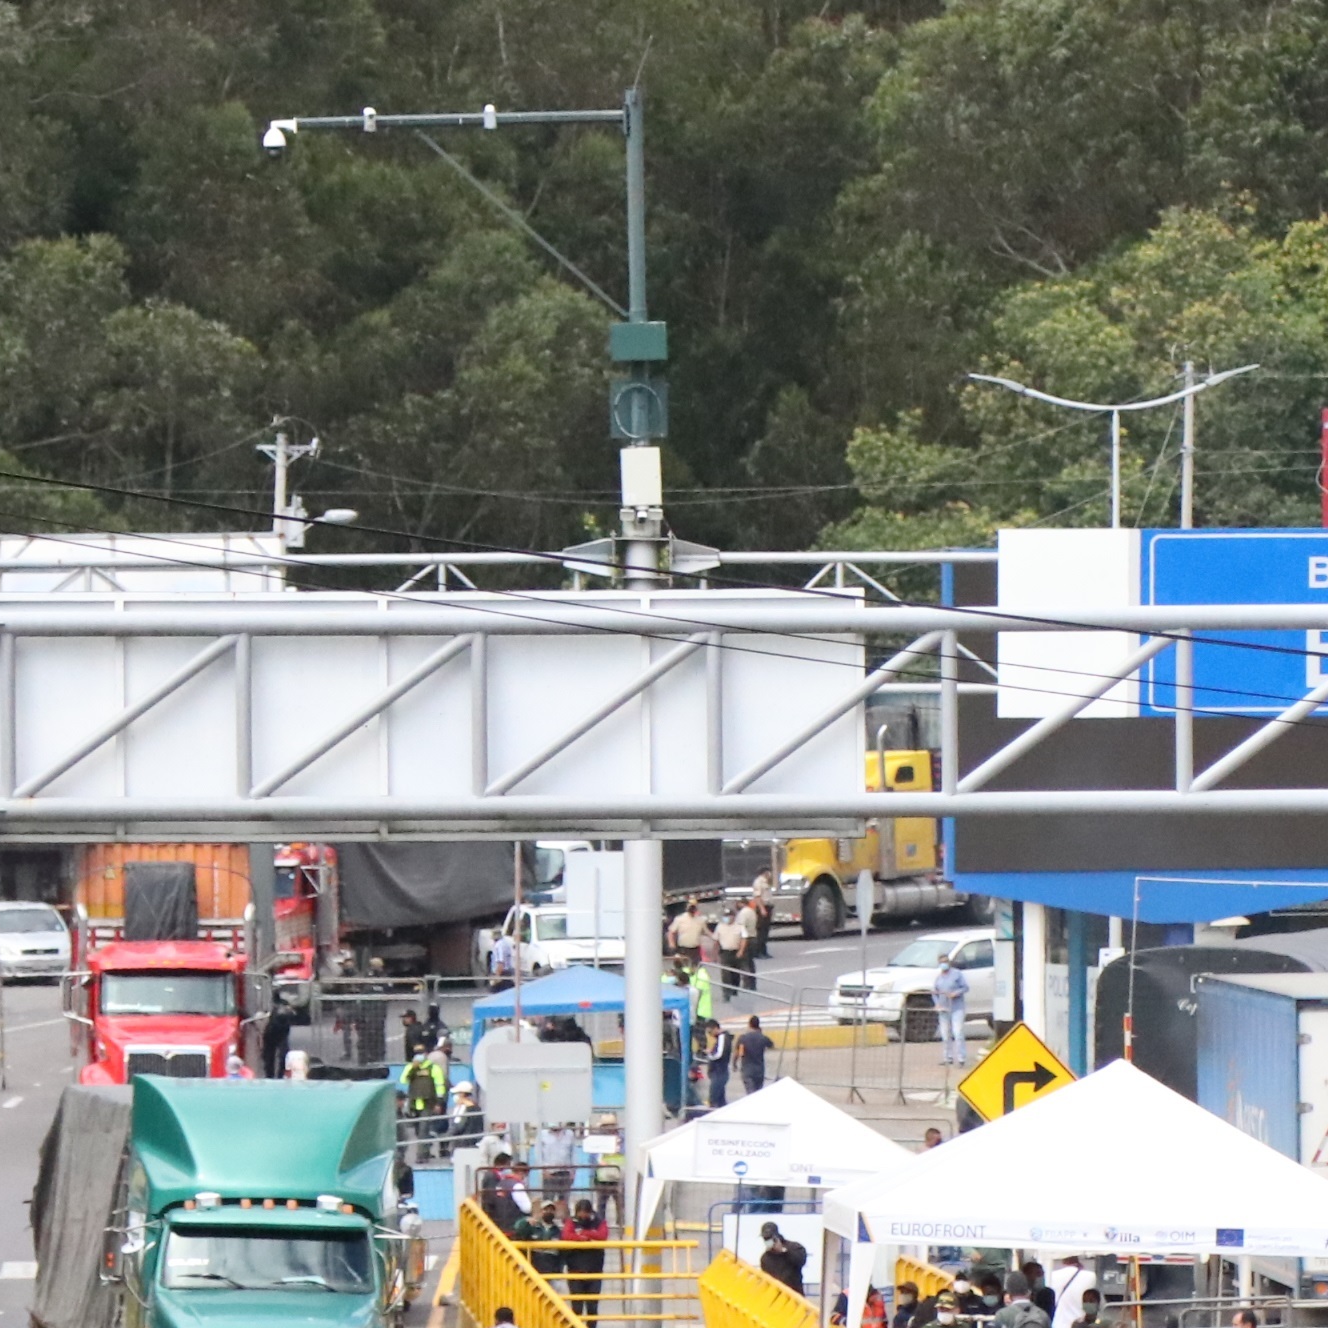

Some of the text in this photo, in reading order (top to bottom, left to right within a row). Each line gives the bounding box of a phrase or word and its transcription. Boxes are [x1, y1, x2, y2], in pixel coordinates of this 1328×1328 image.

[707, 1138, 776, 1149] DESINFECCIÓN
[712, 1149, 771, 1158] DE CALZADO
[890, 1221, 987, 1239] EUROFRONT
